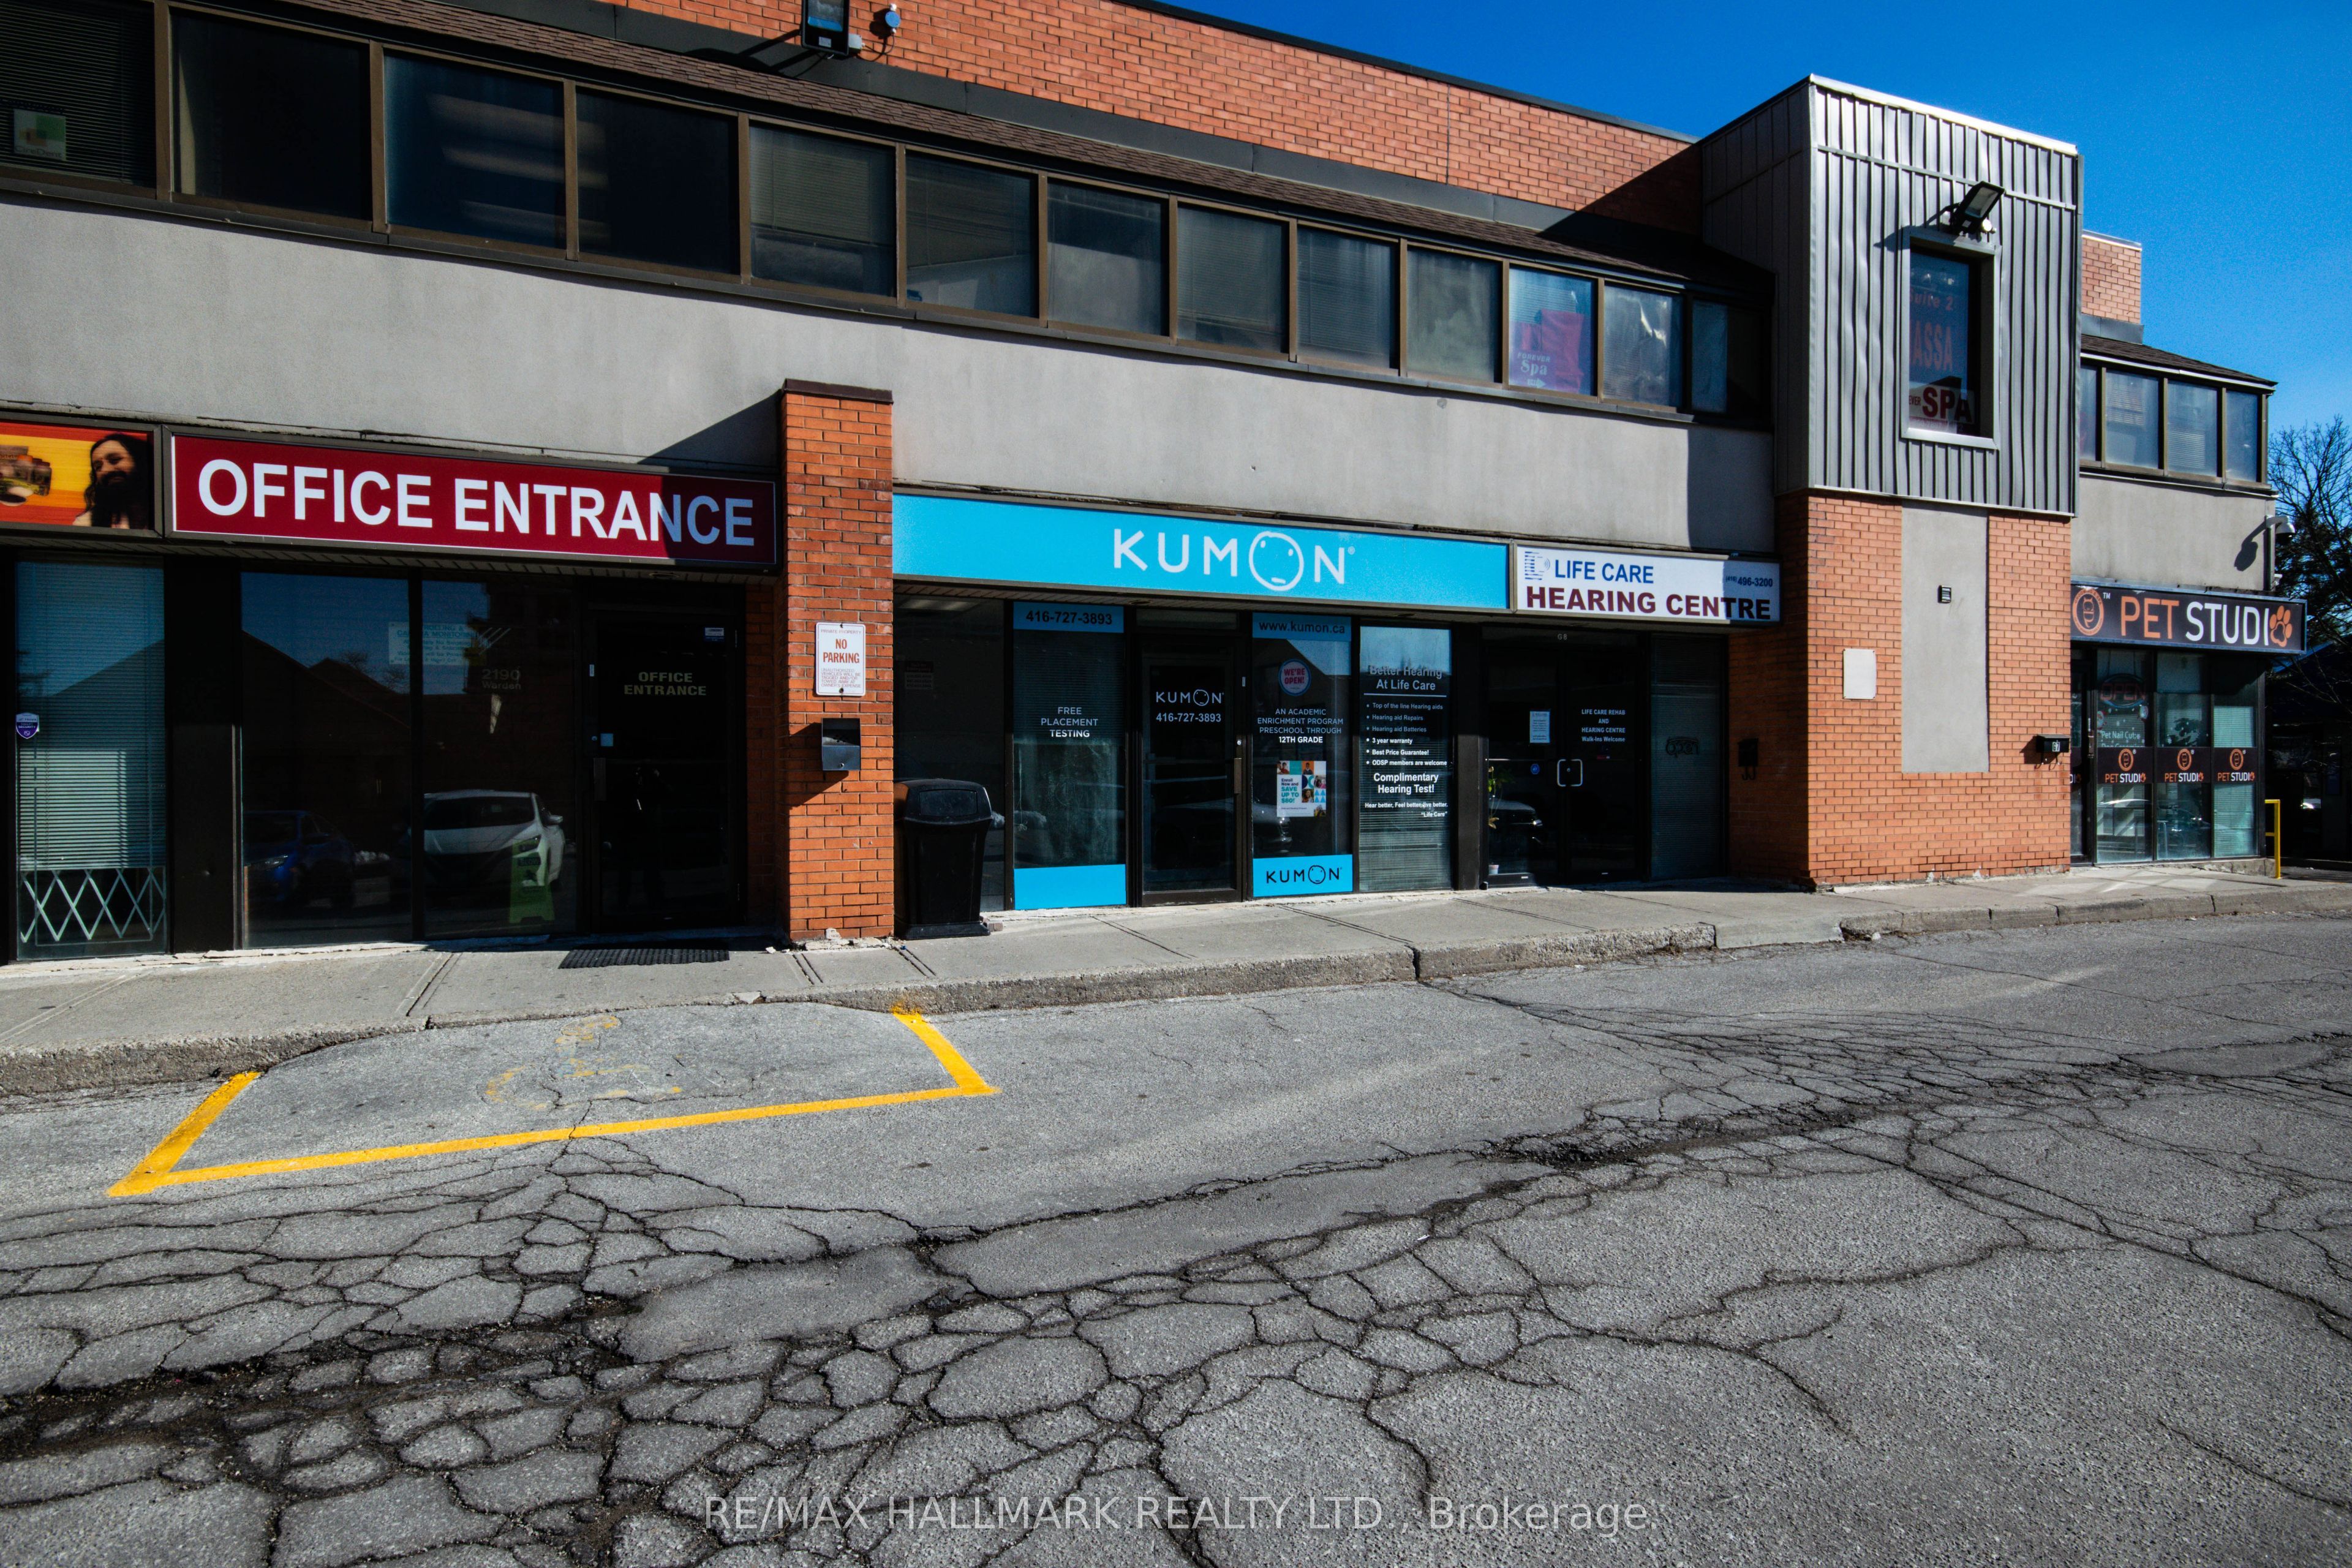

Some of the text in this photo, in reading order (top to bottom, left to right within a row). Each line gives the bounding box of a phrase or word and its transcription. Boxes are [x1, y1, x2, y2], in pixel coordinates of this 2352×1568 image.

[1518, 352, 1551, 363] FOREVER
[1520, 360, 1548, 376] Spa
[1923, 386, 1972, 422] SPA
[198, 459, 755, 546] OFFICE ENTRANCE
[1555, 559, 1654, 584] LIFE CARE
[1738, 576, 1774, 588] 496-3200
[1526, 586, 1771, 620] HEARING CENTRE
[1026, 610, 1113, 625] 416-727-3893
[2120, 595, 2180, 639] PET
[1259, 620, 1346, 634] www.kumon.ca
[835, 638, 847, 649] NO
[823, 652, 860, 663] PARKING
[481, 669, 521, 680] 2190
[638, 671, 693, 682] OFFICE
[1369, 666, 1442, 679] Better Hearing
[481, 680, 521, 690] Warden
[624, 684, 707, 696] ENTRANCE
[1376, 679, 1436, 690] At Life Care
[2100, 683, 2147, 701] OPEN
[1041, 718, 1099, 726] PLACEMENT
[1156, 712, 1222, 723] 416-727-3893
[2101, 730, 2111, 739] Pet
[2112, 730, 2124, 739] Nail
[1373, 772, 1439, 783] Complimentary
[2105, 773, 2119, 783] PET
[2164, 772, 2178, 783] PET
[2217, 772, 2230, 782] PET
[1378, 784, 1434, 795] Hearing Test!
